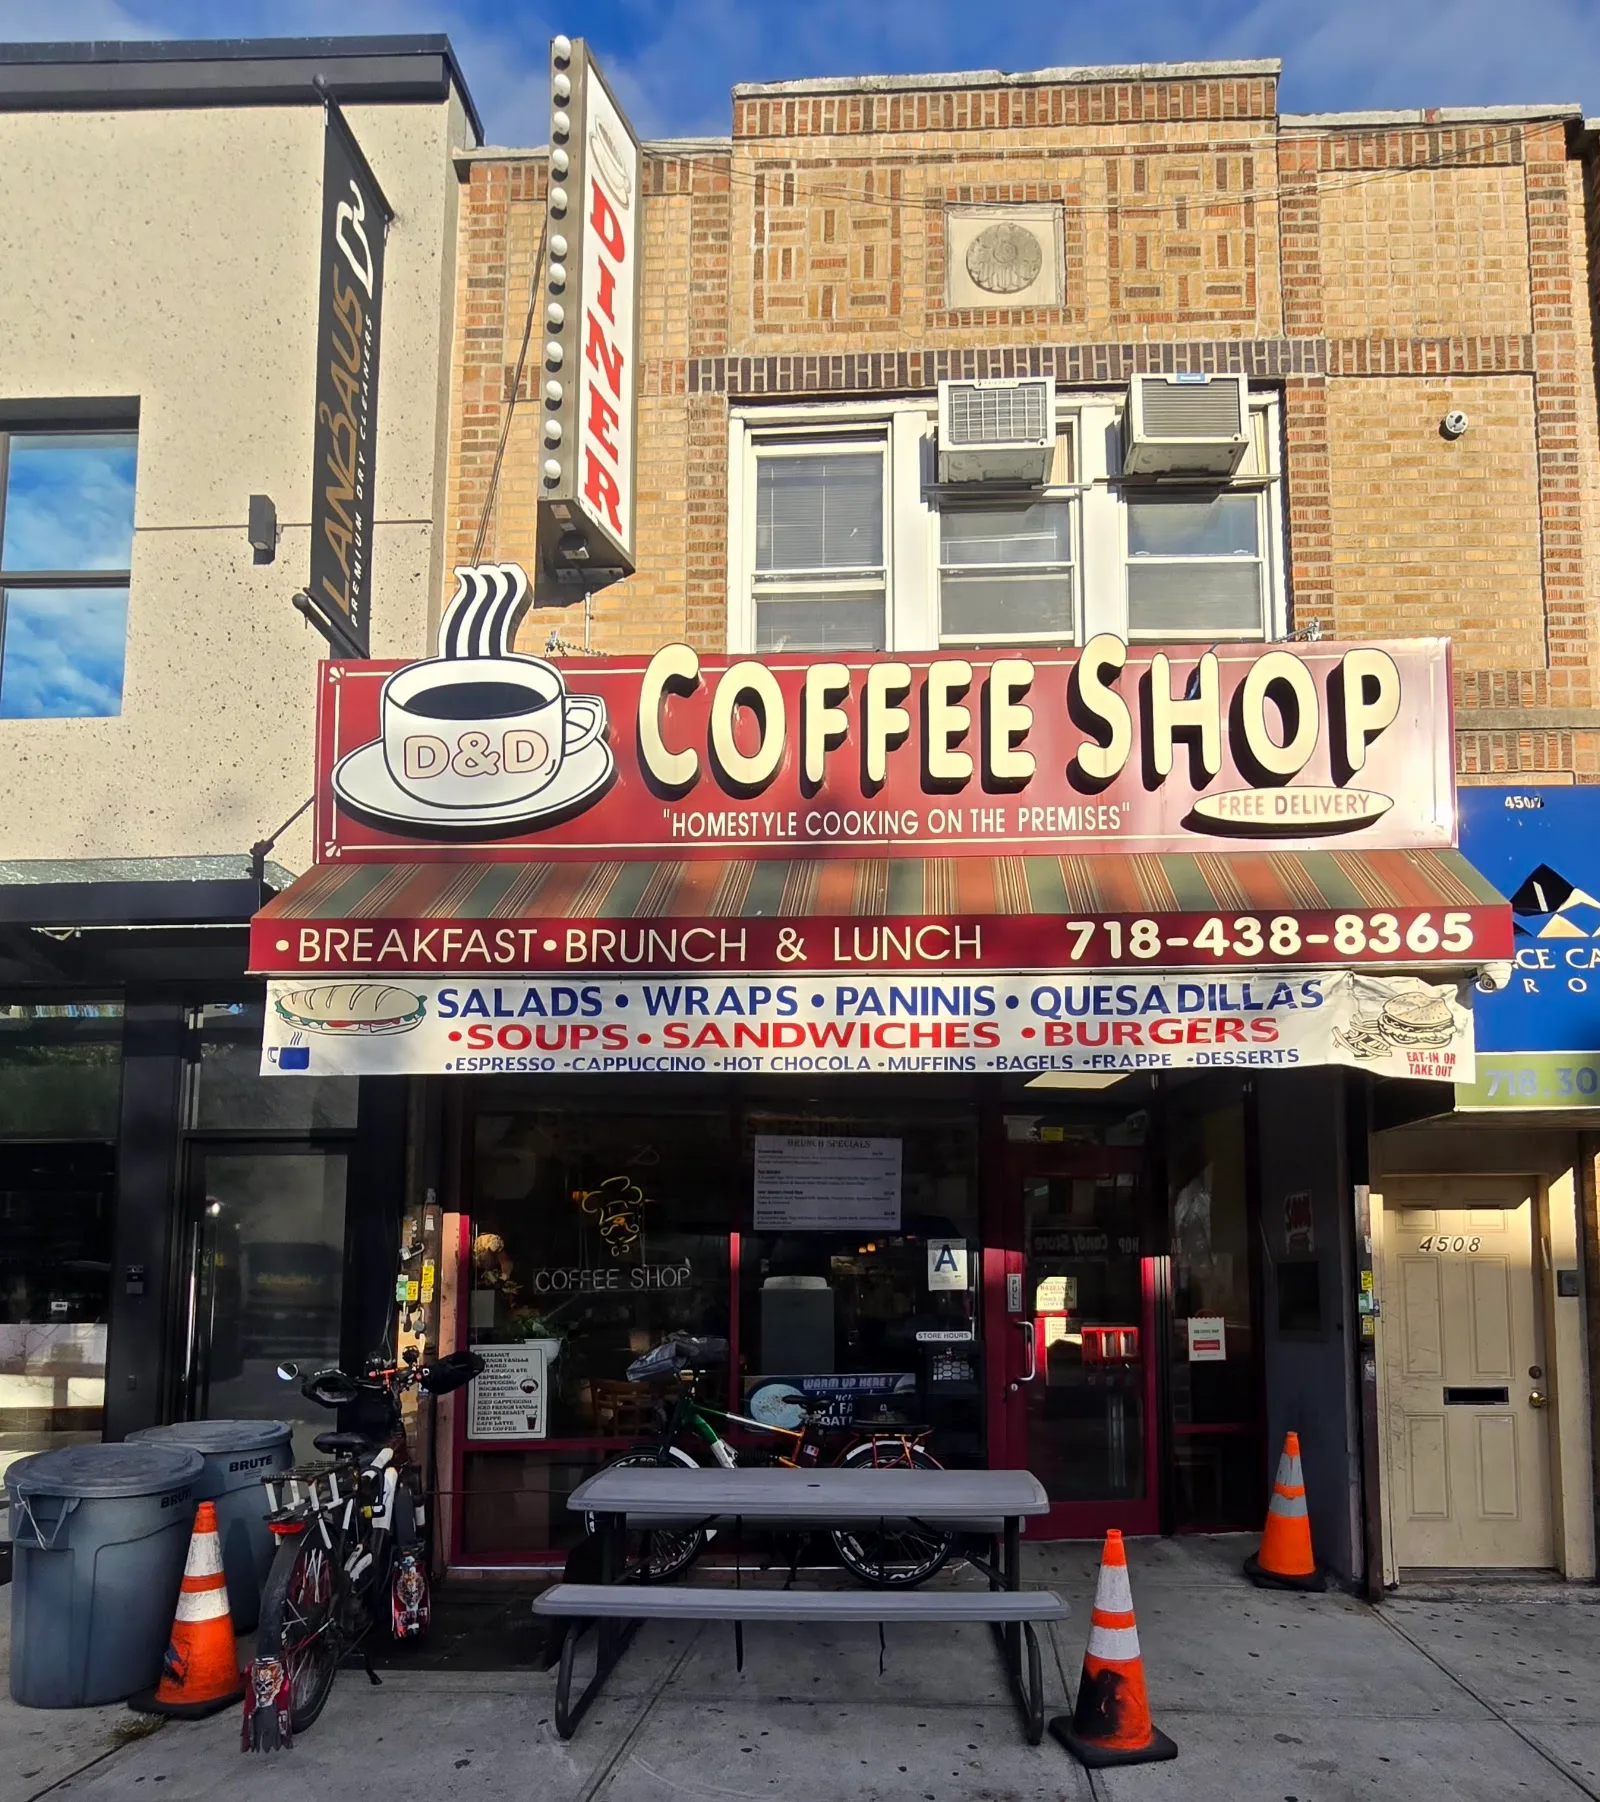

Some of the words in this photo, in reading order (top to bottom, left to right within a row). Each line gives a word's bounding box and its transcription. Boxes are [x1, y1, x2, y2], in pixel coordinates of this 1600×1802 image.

[583, 176, 625, 536] DINER
[359, 314, 373, 440] CLEANERS
[356, 450, 366, 500] DRY
[350, 511, 363, 628] PREMIUM
[638, 643, 1036, 798] COFFEE
[1069, 633, 1401, 792] SHOP
[403, 728, 549, 779] D&D
[1217, 795, 1265, 816] FREE
[1274, 794, 1370, 815] DELIVERY
[663, 808, 797, 837] "HOMESTYLE
[805, 810, 919, 836] COOKING
[927, 808, 967, 834] ON
[969, 808, 1006, 833] THE
[1018, 805, 1130, 833] PREMISES"
[299, 928, 537, 963] BREAKFAST
[564, 927, 747, 963] BRUNCH
[776, 927, 807, 963] &
[834, 925, 982, 962] LUNCH
[1066, 913, 1474, 960] 718-438-8365
[1512, 949, 1556, 969] CE
[437, 986, 603, 1018] SALADS
[642, 985, 798, 1017] WRAPS
[836, 985, 996, 1017] PANINIS
[1030, 979, 1323, 1020] QUESADILLAS
[466, 1023, 629, 1051] SOUPS
[663, 1022, 1001, 1049] SANDWICHES
[1044, 1017, 1279, 1046] BURGERS
[455, 1056, 555, 1071] ESPRESSO
[571, 1056, 706, 1071] CAPPUCCINO
[723, 1056, 764, 1071] HOT
[770, 1056, 871, 1071] CHOCOLA
[888, 1056, 976, 1071] MUFFINS
[996, 1055, 1073, 1070] BAGELS
[1092, 1054, 1172, 1068] FRAPPE
[1196, 1049, 1299, 1065] DESSERTS
[1406, 1051, 1439, 1063] EAT-IN
[1444, 1052, 1456, 1065] OR
[1409, 1063, 1433, 1076] TAKE
[1435, 1065, 1452, 1077] OUT
[787, 1139, 824, 1148] BRUNCH
[826, 1140, 871, 1149] SPECIALS
[934, 1244, 958, 1272] A
[1419, 1236, 1481, 1252] 4508
[535, 1269, 620, 1291] COFFEE
[630, 1266, 691, 1289] SHOP
[803, 1378, 839, 1389] WARM
[841, 1377, 857, 1388] UP
[859, 1376, 885, 1388] HERE
[229, 1455, 273, 1472] BRUTE
